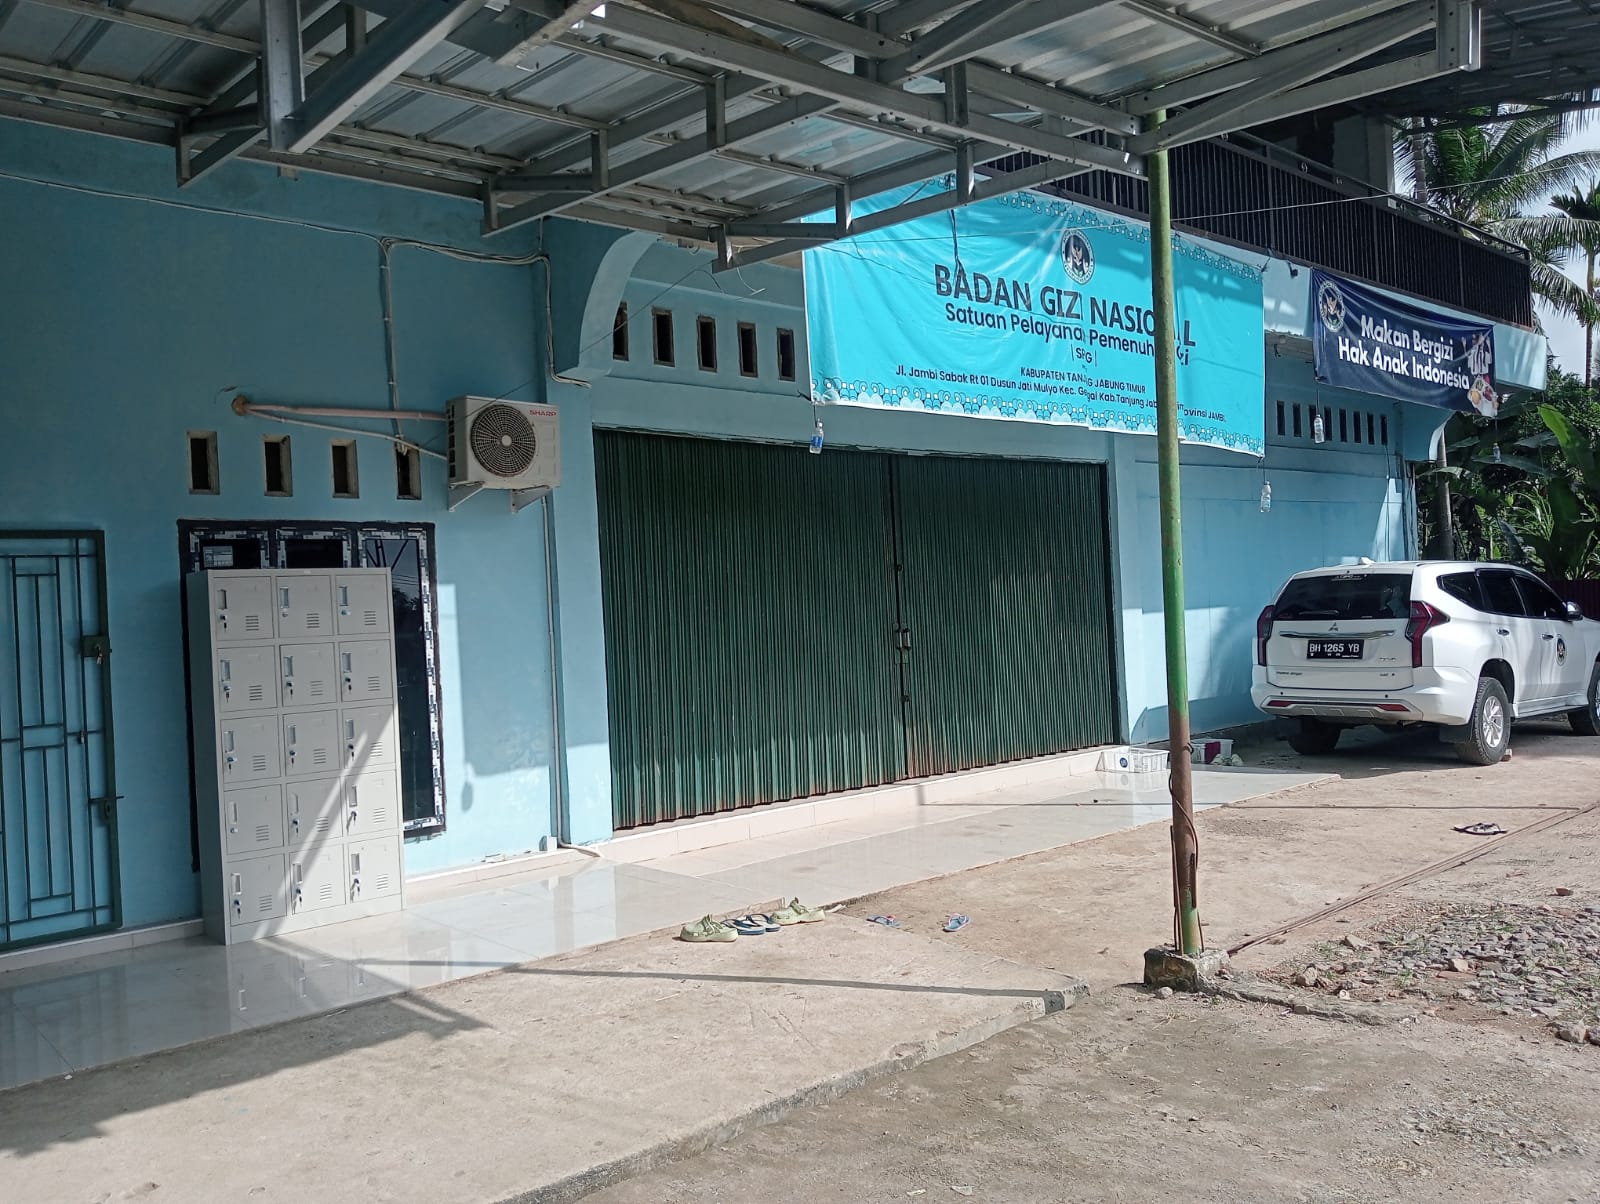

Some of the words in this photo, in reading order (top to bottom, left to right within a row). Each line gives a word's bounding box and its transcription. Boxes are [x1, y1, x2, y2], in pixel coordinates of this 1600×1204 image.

[935, 264, 1032, 311] BADAN
[945, 303, 1006, 330] Satuan
[1089, 329, 1154, 357] Pemenuh
[1360, 314, 1410, 350] Makan
[1413, 329, 1454, 363] Bergizi
[908, 367, 938, 380] Jambi
[939, 370, 968, 384] Sabak
[969, 374, 979, 385] Rt
[980, 375, 989, 386] 01
[991, 377, 1016, 389] Dusun
[1017, 381, 1032, 392] Jati
[1059, 385, 1077, 395] Kec.
[1020, 366, 1065, 381] KABUPATEN
[1095, 379, 1125, 391] JABUNG
[1126, 383, 1146, 394] TIMUR
[1337, 336, 1370, 367] Hak
[1372, 346, 1410, 376] Anak
[1412, 356, 1470, 390] Indonesia
[529, 409, 557, 417] SHARP
[1309, 643, 1321, 653] BH
[1323, 643, 1345, 653] 1265
[1348, 643, 1360, 653] YB
